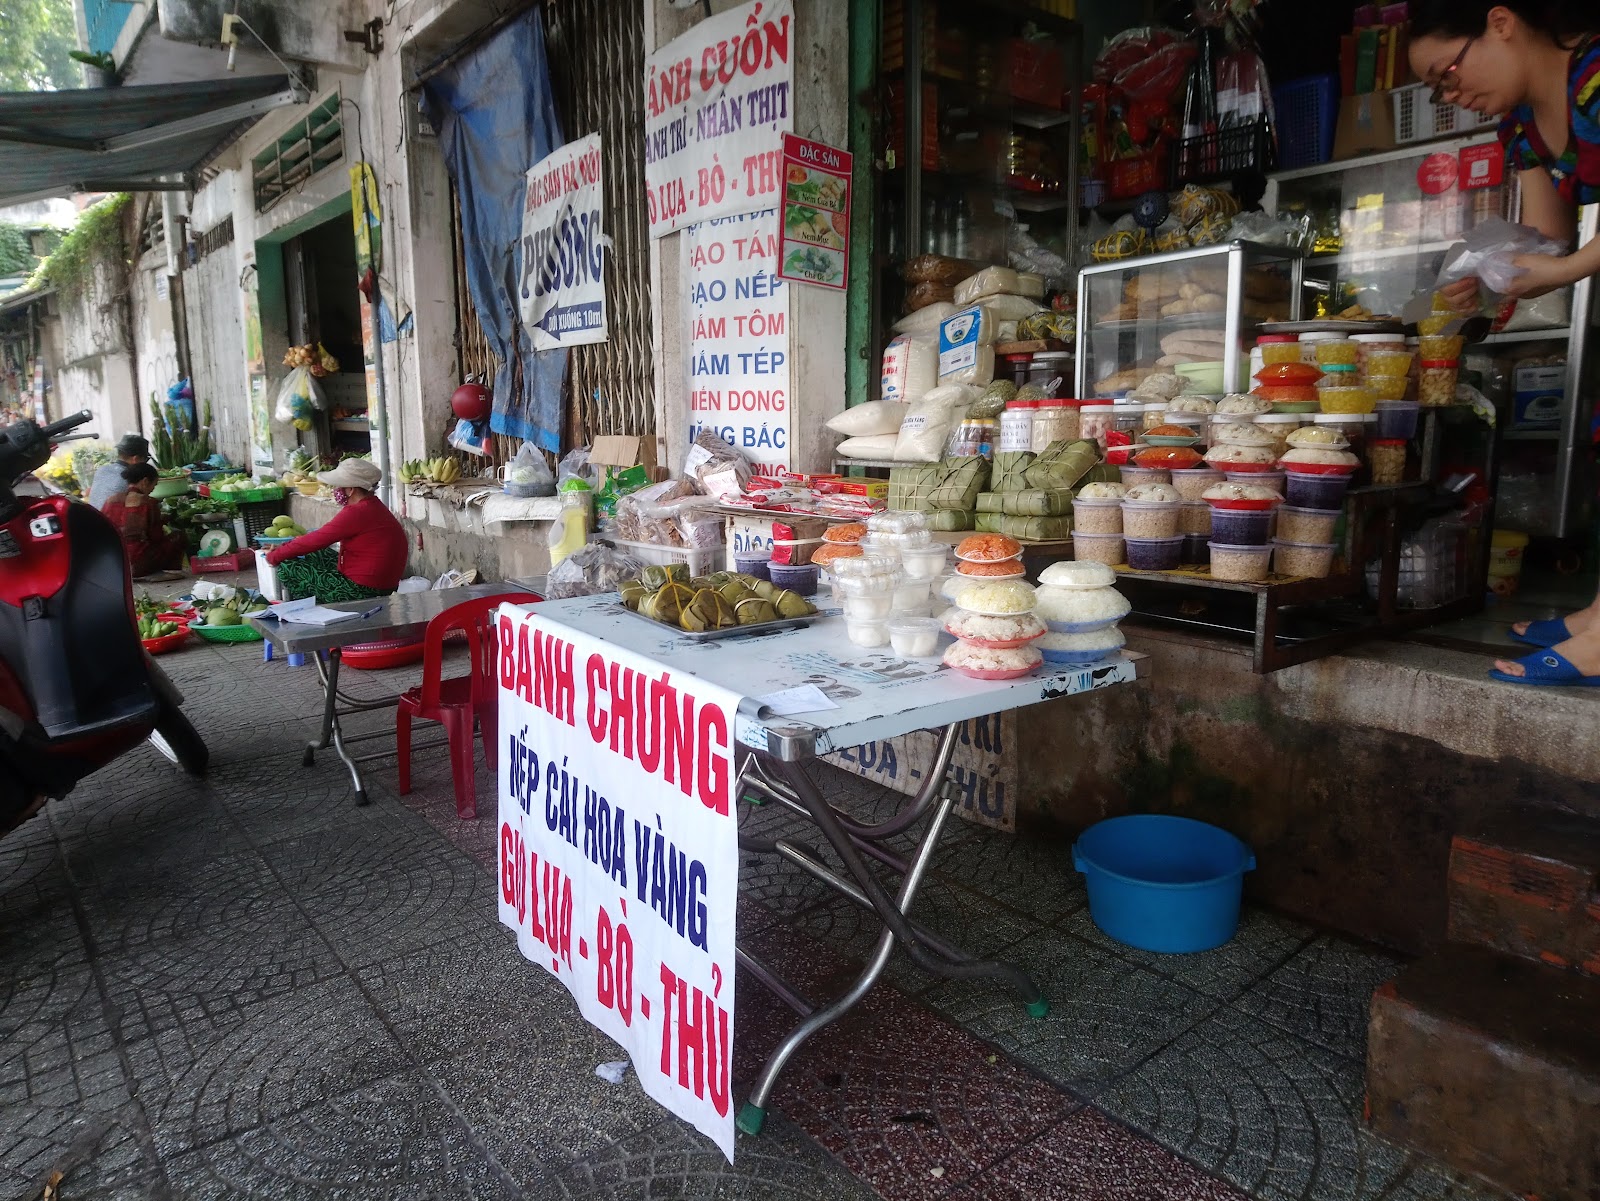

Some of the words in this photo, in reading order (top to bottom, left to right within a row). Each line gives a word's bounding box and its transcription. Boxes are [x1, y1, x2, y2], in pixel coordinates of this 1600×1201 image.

[700, 2, 790, 92] CUỐN
[696, 89, 743, 143] NHÂN
[746, 80, 790, 132] THỊT
[800, 142, 820, 162] ĐẶC
[822, 149, 840, 168] SẢN
[659, 176, 687, 228] LỤA
[697, 152, 726, 207] BÒ
[690, 241, 726, 272] ẠO
[691, 279, 727, 309] ẠO
[583, 309, 602, 327] 10m
[692, 313, 726, 341] ẮM
[733, 308, 785, 338] TÔM
[691, 349, 730, 377] ẮM
[737, 346, 785, 375] TÉP
[728, 389, 785, 412] DONG
[743, 421, 786, 449] BẮC
[499, 611, 576, 728] BÁNH
[509, 724, 541, 816] NẾP
[545, 755, 579, 848] CÁI
[583, 784, 628, 889] HOA
[634, 813, 709, 954] VÀNG
[500, 815, 527, 926] GIÒ
[530, 851, 574, 974] LỤA
[596, 896, 635, 1029] BÒ
[660, 961, 729, 1119] THỦ
